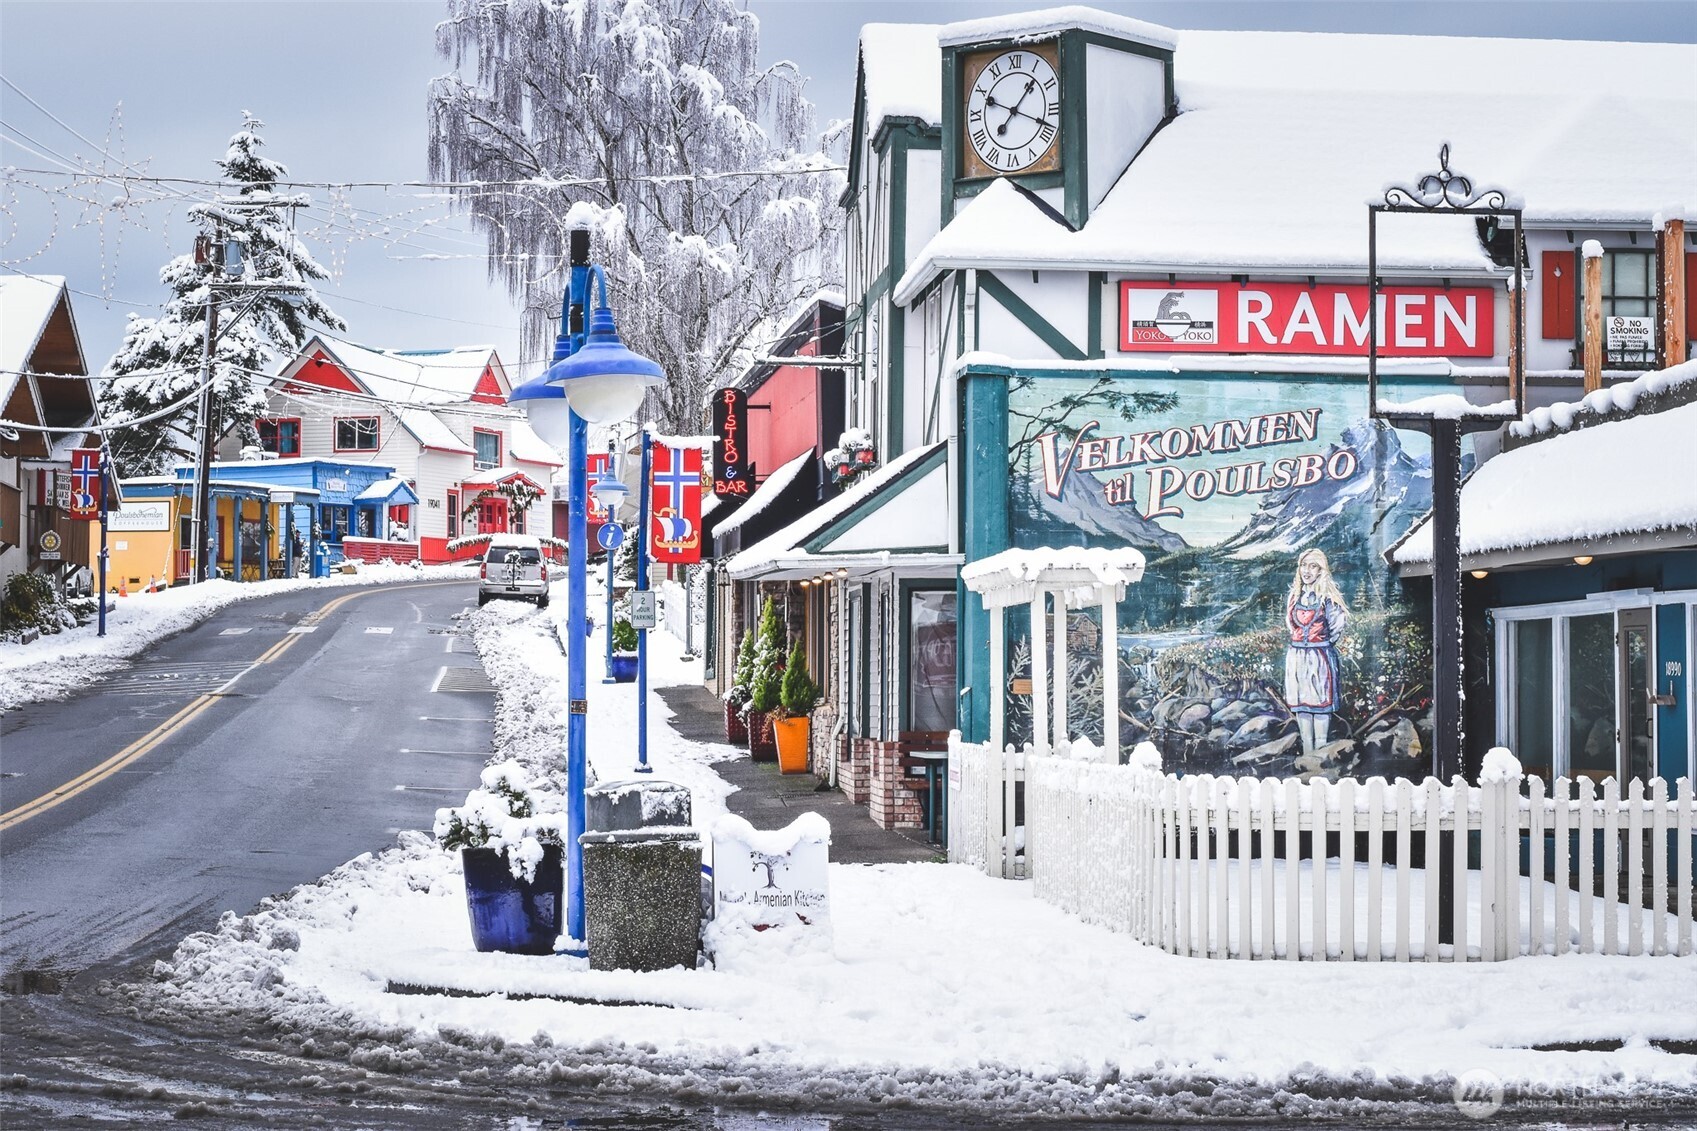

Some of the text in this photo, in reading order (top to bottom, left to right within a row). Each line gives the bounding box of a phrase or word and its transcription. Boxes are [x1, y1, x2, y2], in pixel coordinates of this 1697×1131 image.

[1136, 330, 1212, 341] YOKO YOKO
[1236, 289, 1478, 349] RAMEN
[723, 390, 738, 463] BISTRO
[725, 465, 737, 480] &
[1037, 407, 1324, 502] VELKOMMEN
[715, 480, 749, 495] BAR
[1103, 449, 1359, 522] til POULSBO
[1666, 661, 1682, 676] 18990
